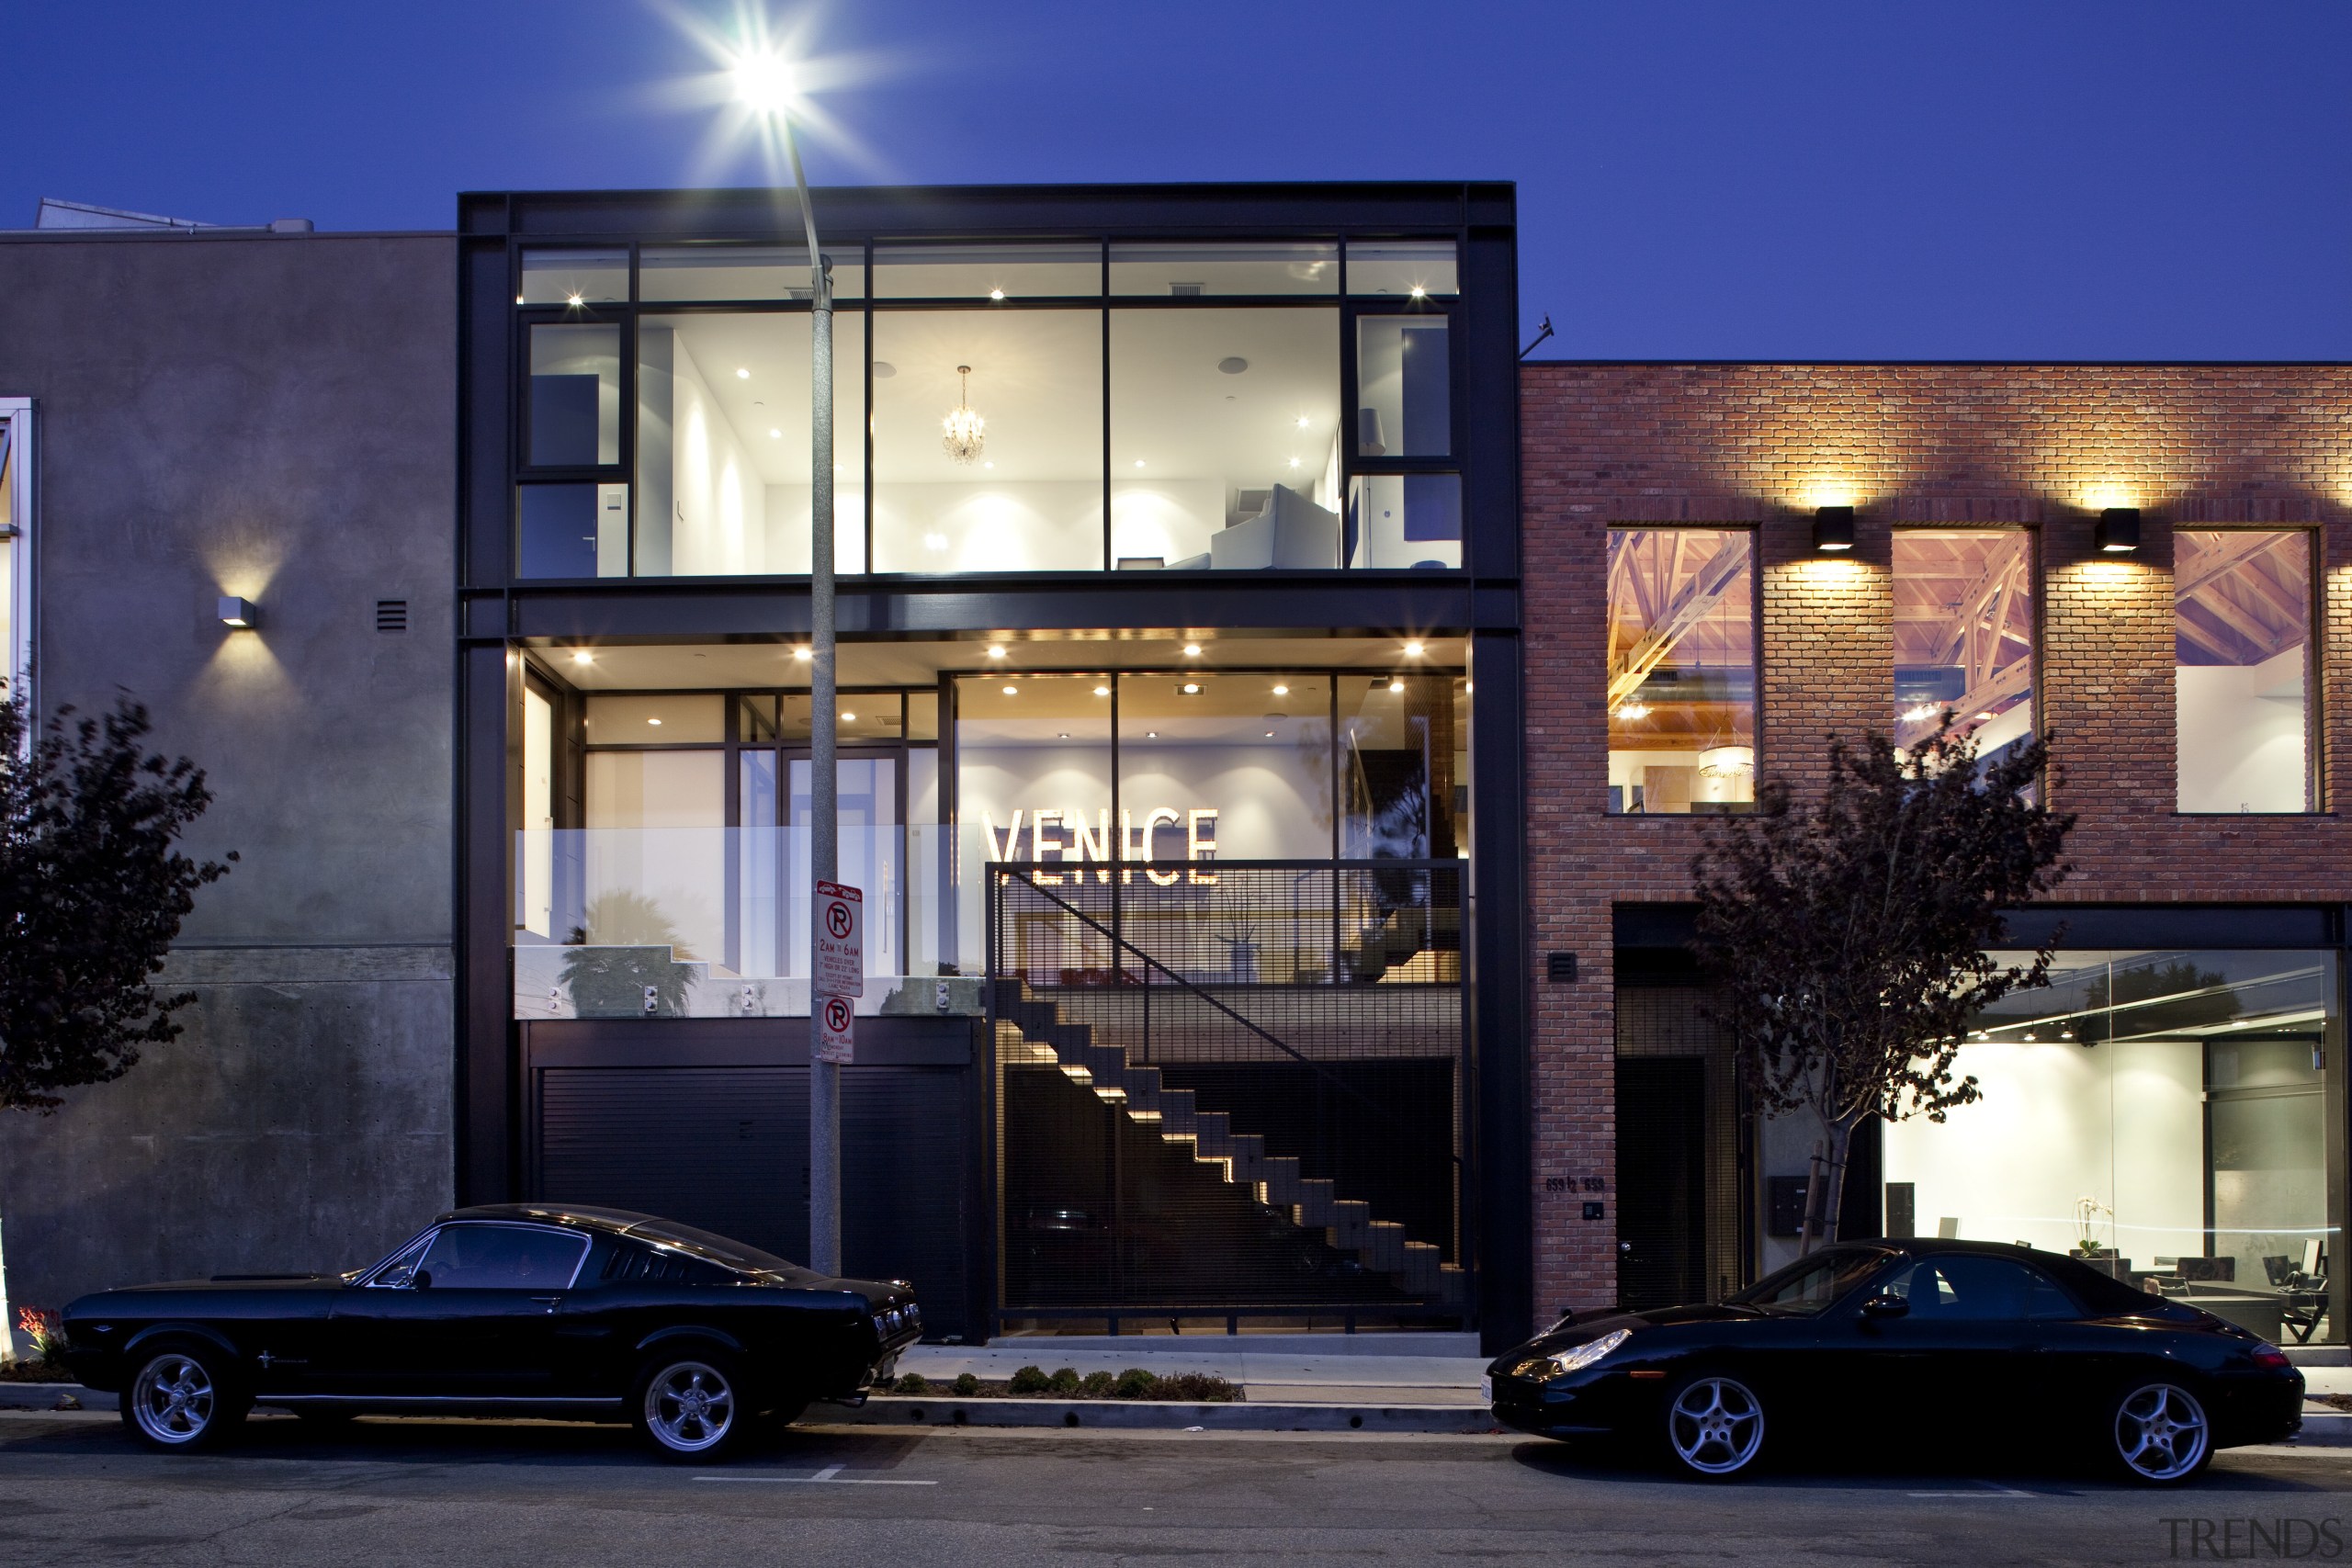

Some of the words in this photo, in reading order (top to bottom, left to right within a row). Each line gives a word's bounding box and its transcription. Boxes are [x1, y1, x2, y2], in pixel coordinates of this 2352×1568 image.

[981, 807, 1218, 886] VENICE
[820, 939, 835, 953] 2AM
[843, 943, 859, 957] 6AM
[824, 956, 843, 964] VEHICLES
[823, 1032, 834, 1043] 8AM
[839, 1034, 853, 1044] 10AM
[1546, 1178, 1564, 1191] 659
[1585, 1178, 1604, 1191] 659
